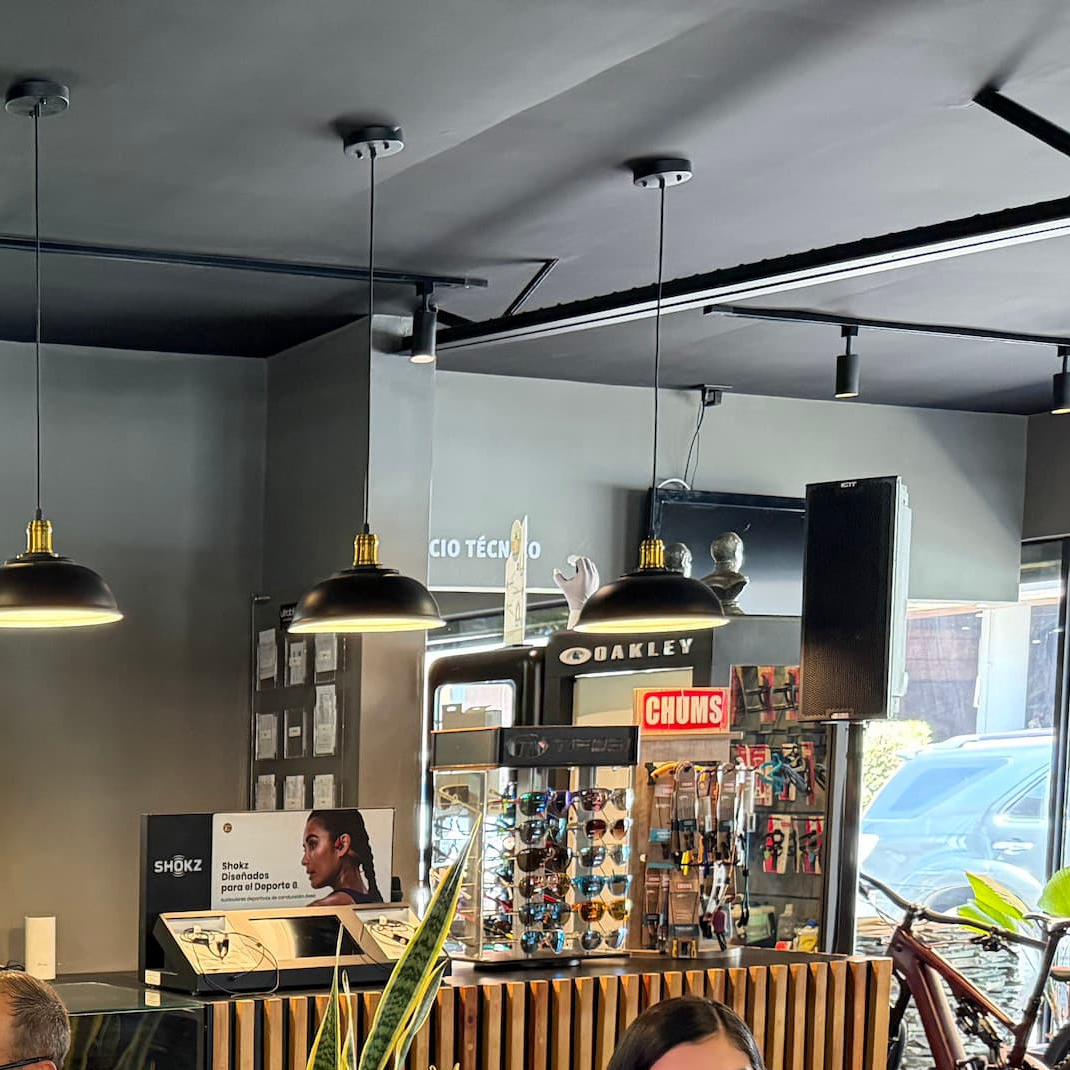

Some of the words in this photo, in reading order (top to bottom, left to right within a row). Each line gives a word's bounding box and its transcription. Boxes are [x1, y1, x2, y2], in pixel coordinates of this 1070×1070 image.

[465, 535, 541, 559] TÉCNO
[593, 638, 694, 662] OAKLEY
[645, 694, 723, 725] CHUMS
[154, 857, 202, 874] SHOKZ
[222, 861, 249, 870] Shokz
[221, 872, 269, 881] Diseñados
[221, 884, 243, 894] para
[254, 882, 291, 892] Deporte
